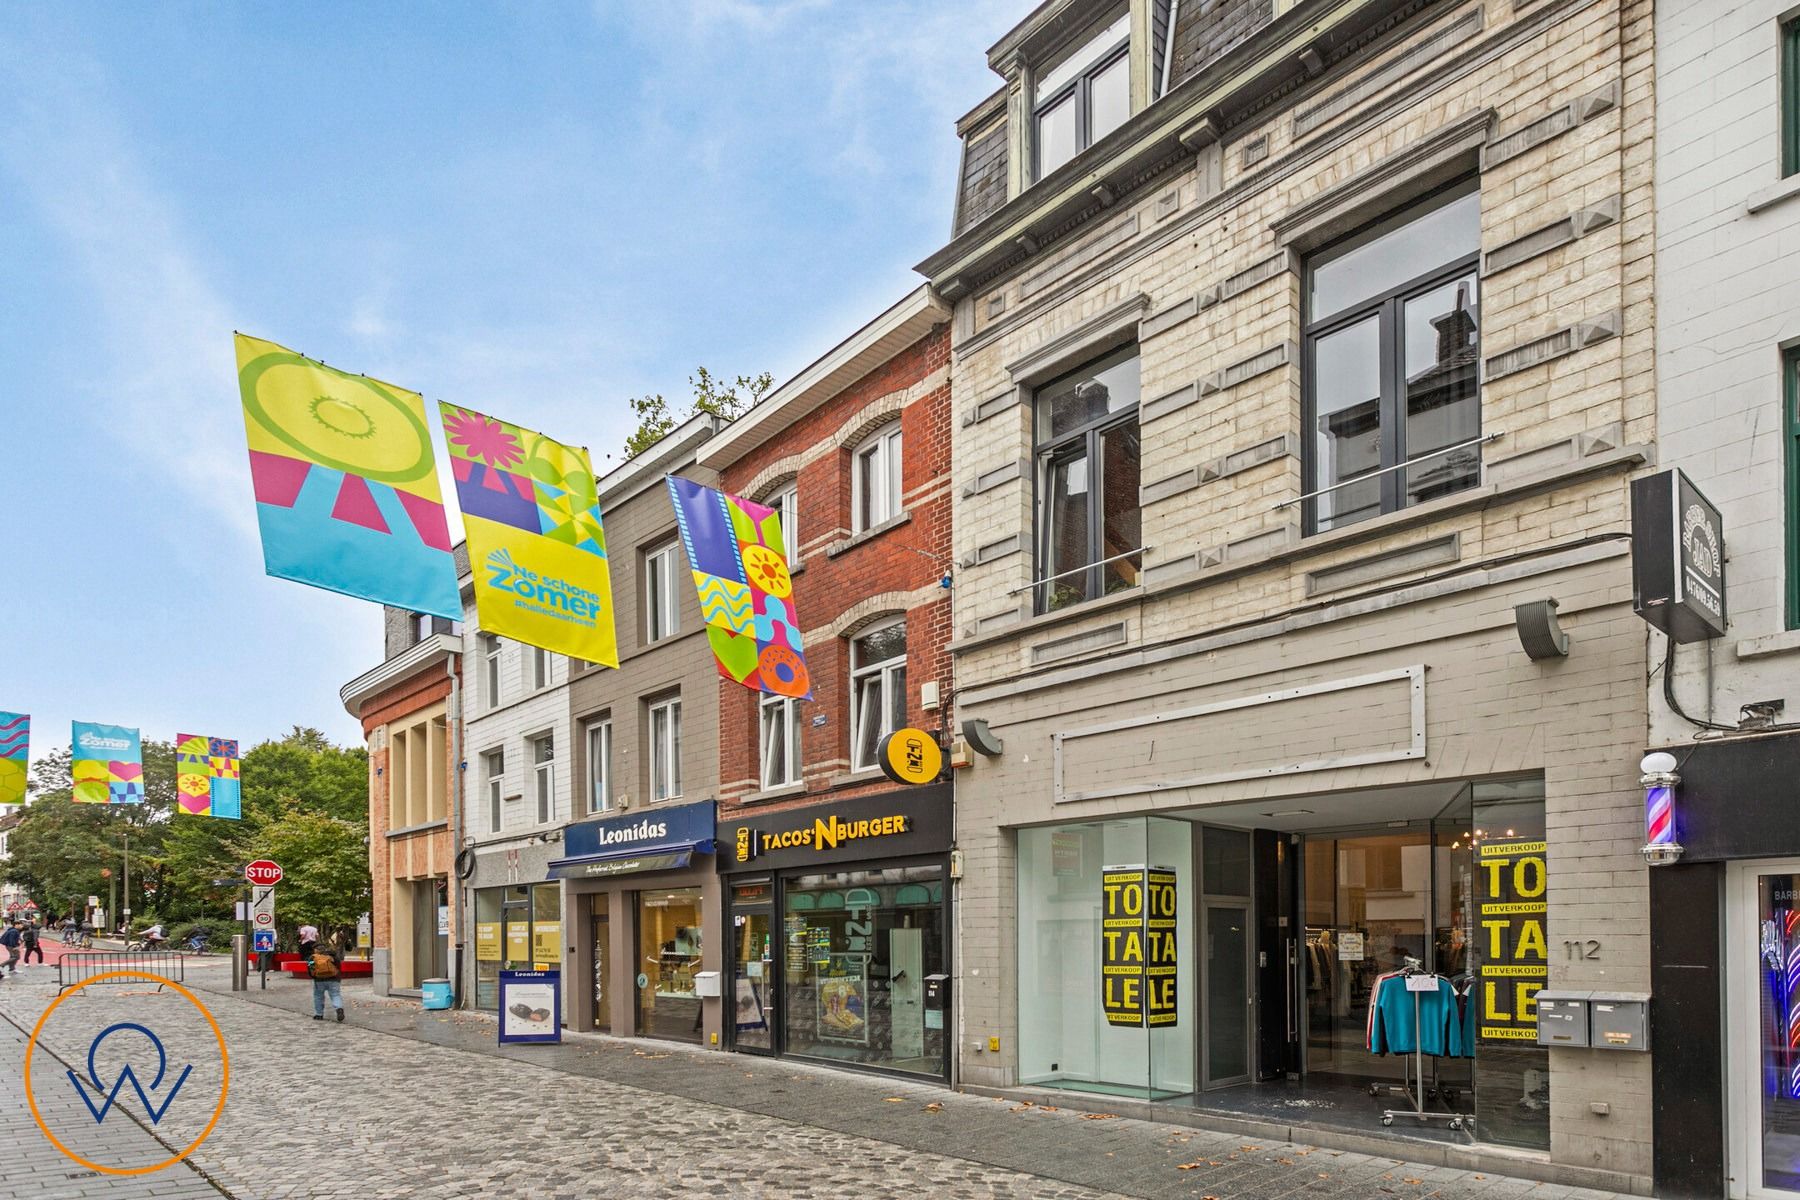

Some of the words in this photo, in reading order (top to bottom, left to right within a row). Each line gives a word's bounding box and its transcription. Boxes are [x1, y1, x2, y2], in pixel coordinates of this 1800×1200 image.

[486, 563, 601, 620] Zomer
[512, 564, 538, 582] Ne
[542, 576, 600, 602] schone
[599, 819, 667, 845] Leonidas
[837, 815, 905, 841] BURGER
[1484, 843, 1545, 854] UITVERKOOP
[248, 867, 281, 879] STOP
[1481, 857, 1546, 898] TO
[1104, 884, 1142, 915] TO
[1149, 885, 1176, 916] TO
[1484, 905, 1545, 913] UITVERKOOP
[1774, 891, 1800, 900] BARB
[1104, 931, 1143, 962] TA
[1149, 932, 1177, 962] TA
[1481, 920, 1548, 959] TA
[1564, 940, 1601, 961] 112
[1484, 967, 1545, 975] UITVERKOOP
[1106, 978, 1139, 1009] LE
[1149, 979, 1175, 1009] LE
[1485, 982, 1543, 1021] LE
[1484, 1029, 1537, 1039] UITVERKOO
